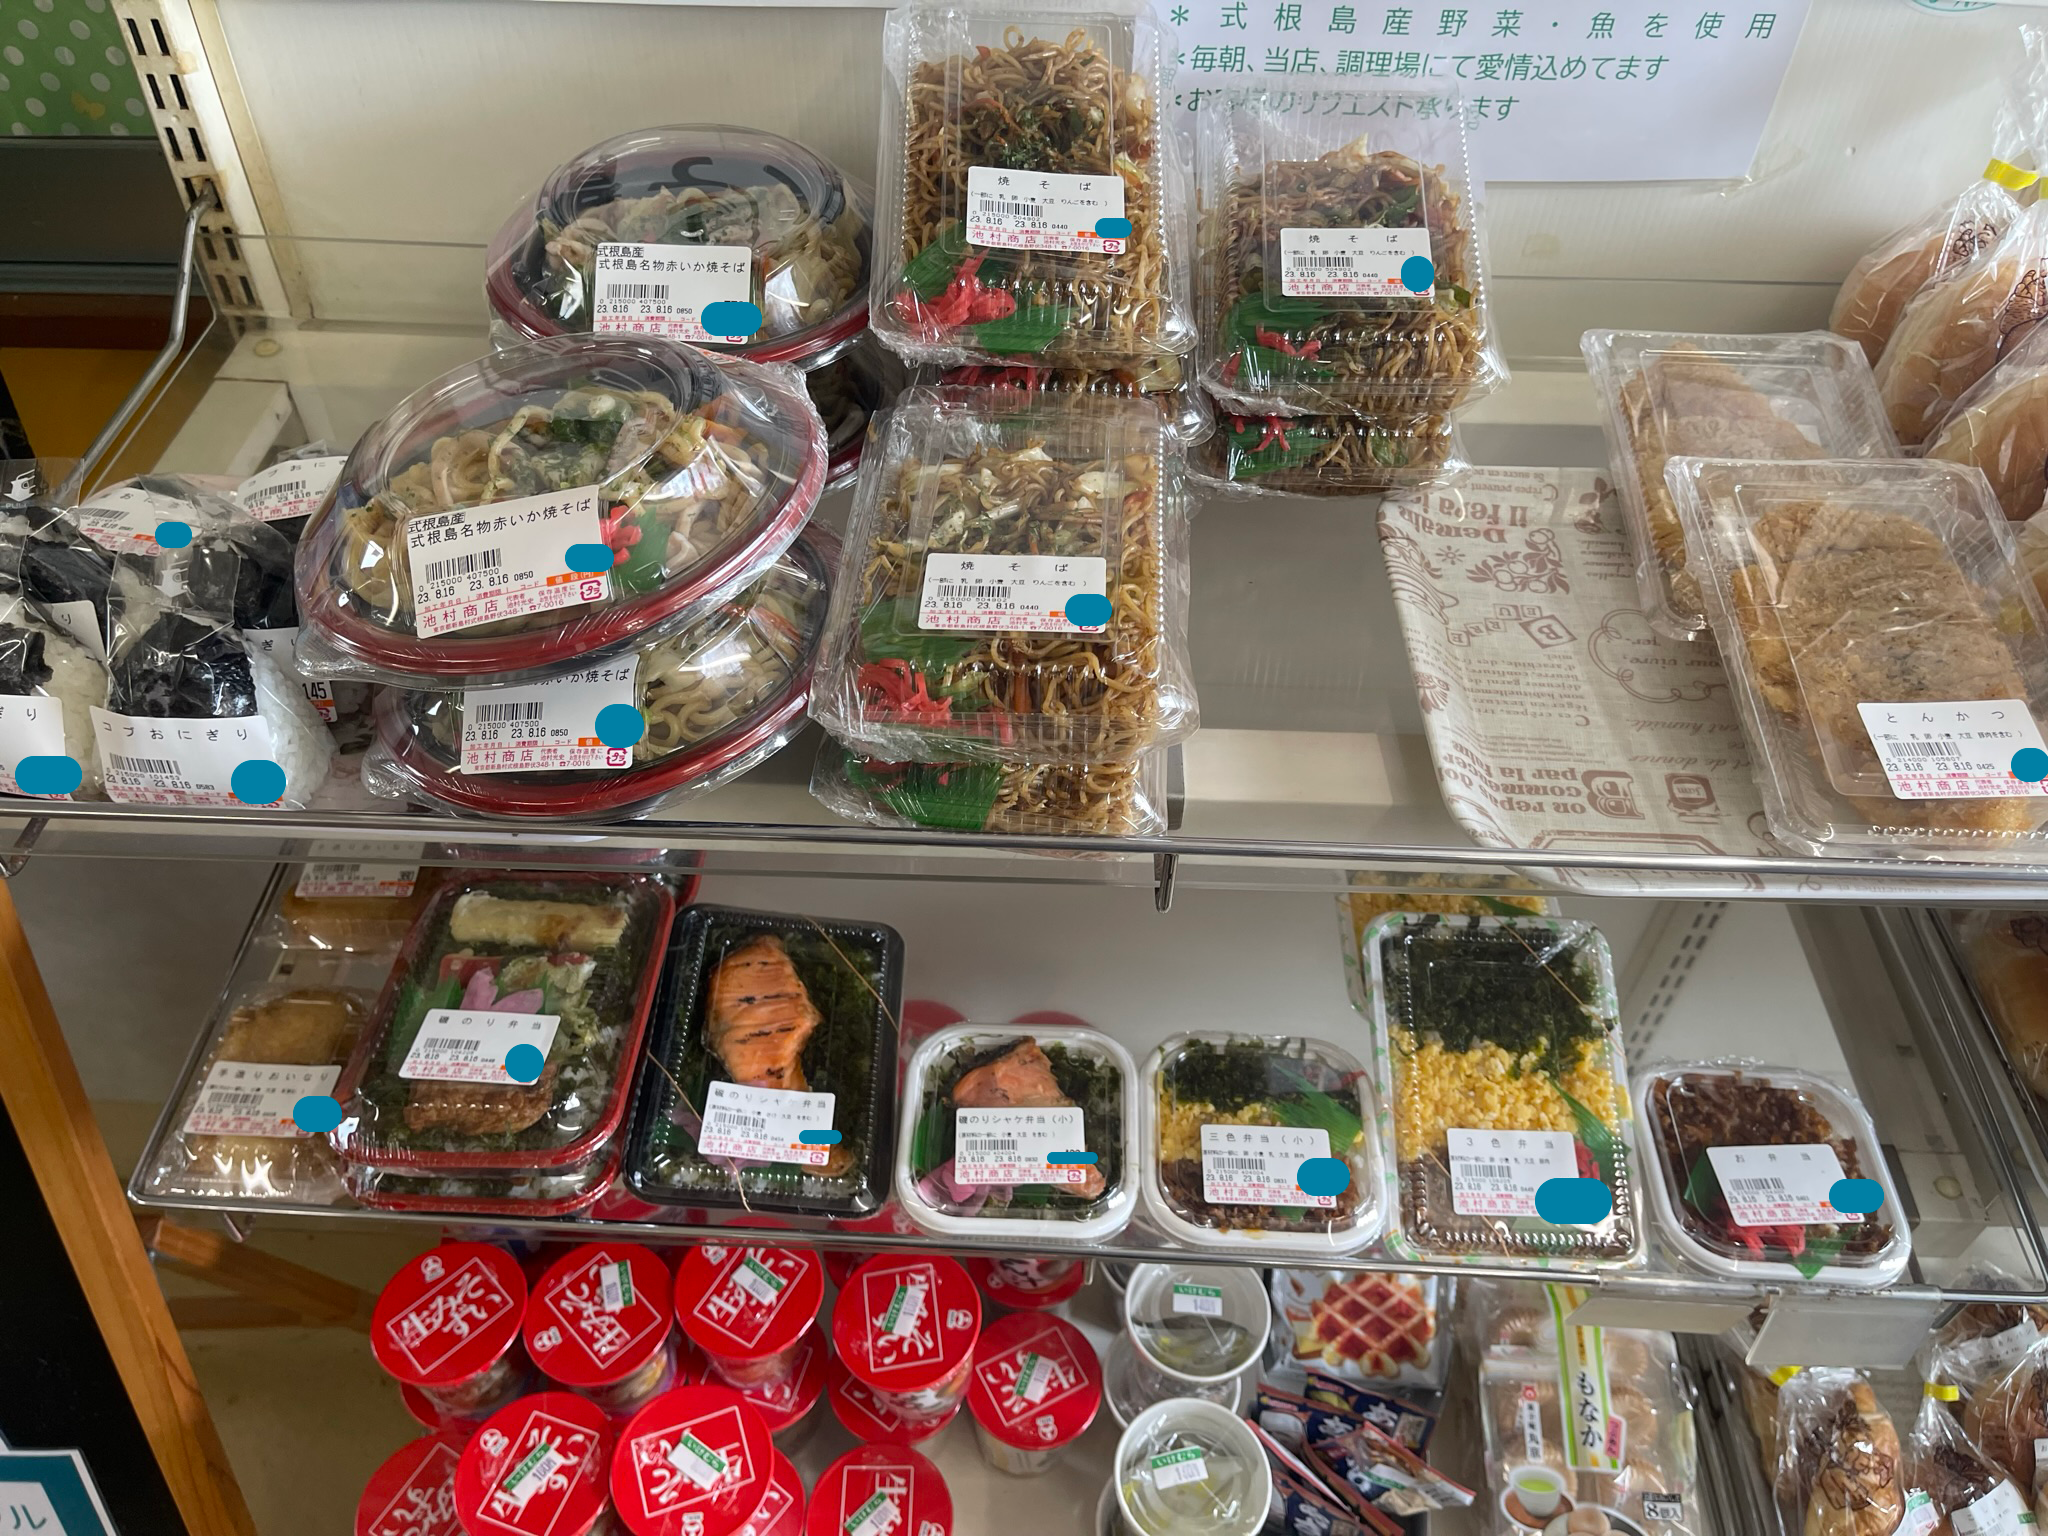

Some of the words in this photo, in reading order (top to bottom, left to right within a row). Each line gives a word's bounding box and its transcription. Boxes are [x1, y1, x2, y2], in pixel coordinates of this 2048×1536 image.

[1220, 4, 1778, 41] 式根島産野菜・魚を使用
[1189, 44, 1670, 82] 毎朝、当店、調理場にて愛情込めてます
[998, 175, 1092, 192] 焼そば
[972, 230, 1037, 244] 池村商店
[1308, 234, 1398, 243] 焼そば
[597, 246, 645, 258] 式根島産
[599, 258, 746, 273] 式根島名物赤いか焼そば
[408, 512, 466, 534] 式根島産
[411, 498, 591, 549] 式根島名物赤いか焼そば
[960, 561, 1068, 573] 焼そば
[423, 600, 499, 629] 池村商店
[925, 615, 1000, 625] 池村商店
[302, 682, 327, 700] 145
[1887, 711, 2005, 724] とんかつ
[467, 750, 534, 765] 池村商店
[1898, 780, 1970, 792] 池村商店
[1209, 1132, 1315, 1146] 三色弁当（小）
[1466, 1137, 1554, 1149] 3色弁当
[1735, 1153, 1812, 1163] お弁当
[1577, 1371, 1604, 1448] もなか
